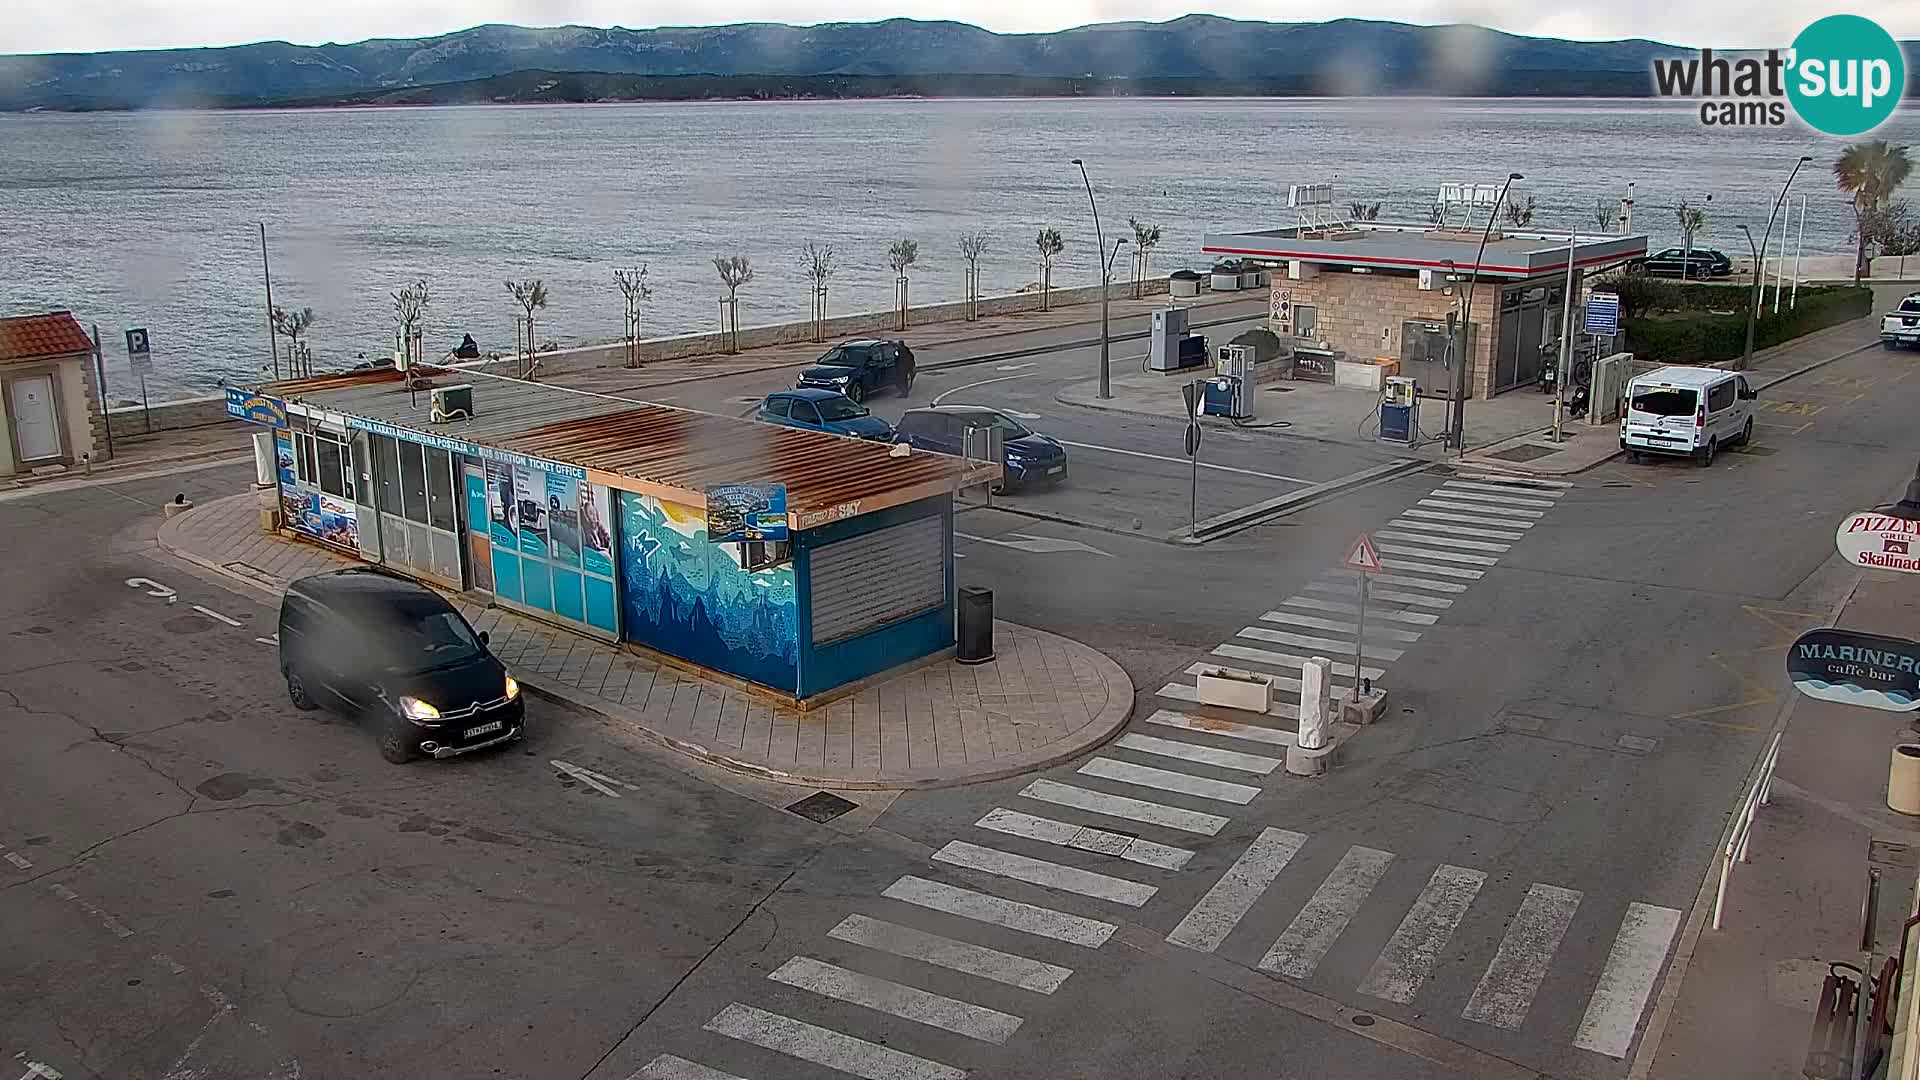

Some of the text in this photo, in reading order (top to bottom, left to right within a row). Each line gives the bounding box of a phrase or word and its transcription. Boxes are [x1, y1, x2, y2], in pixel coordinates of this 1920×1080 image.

[131, 332, 144, 351] P
[396, 428, 437, 447] AUTOBUSNA
[437, 438, 468, 454] POSTAJA
[478, 446, 494, 459] BUS
[494, 451, 526, 466] STATION
[528, 457, 555, 472] TICKET
[555, 464, 583, 479] OFFICE
[1880, 533, 1915, 542] GRILL
[1827, 662, 1896, 682] caffe bar
